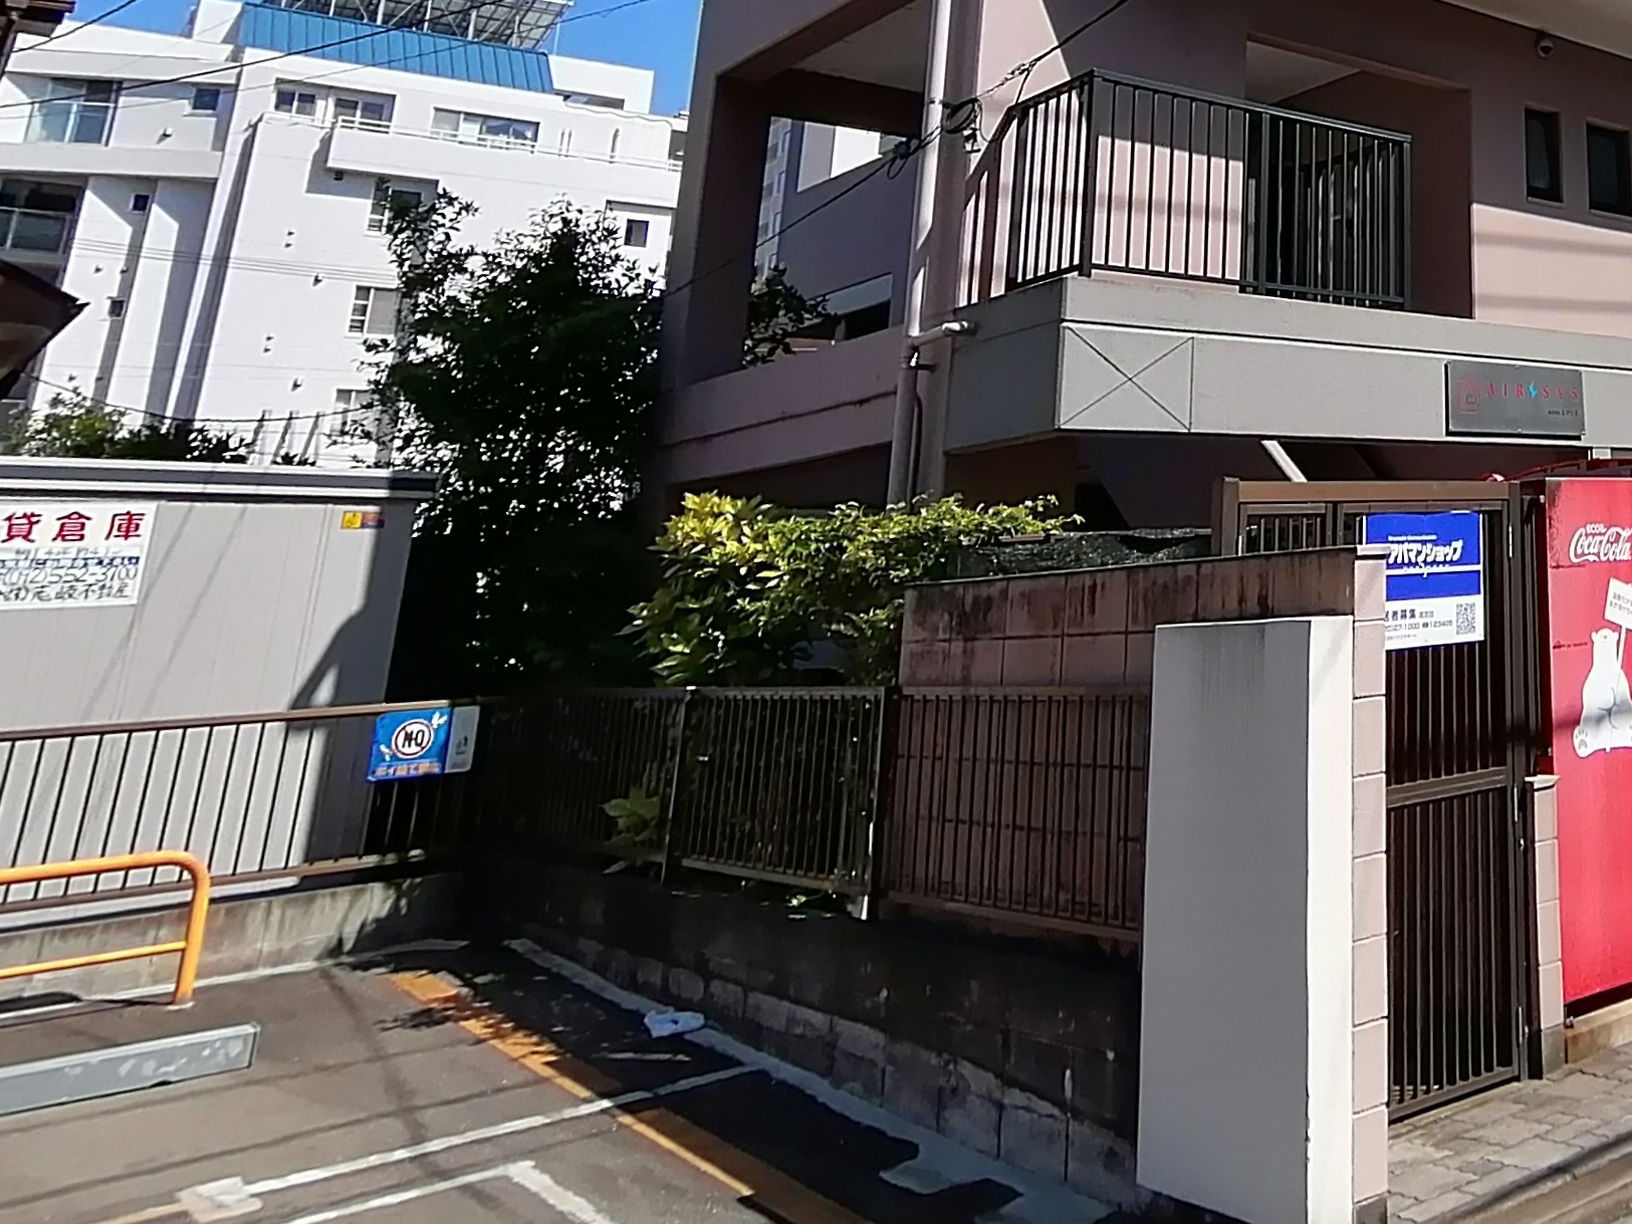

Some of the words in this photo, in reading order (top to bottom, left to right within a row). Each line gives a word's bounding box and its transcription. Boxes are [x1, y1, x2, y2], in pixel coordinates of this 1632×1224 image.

[1, 511, 146, 543] 貸倉庫
[1387, 539, 1463, 564] アパマンショップ
[1569, 527, 1632, 563] Coca-Cola
